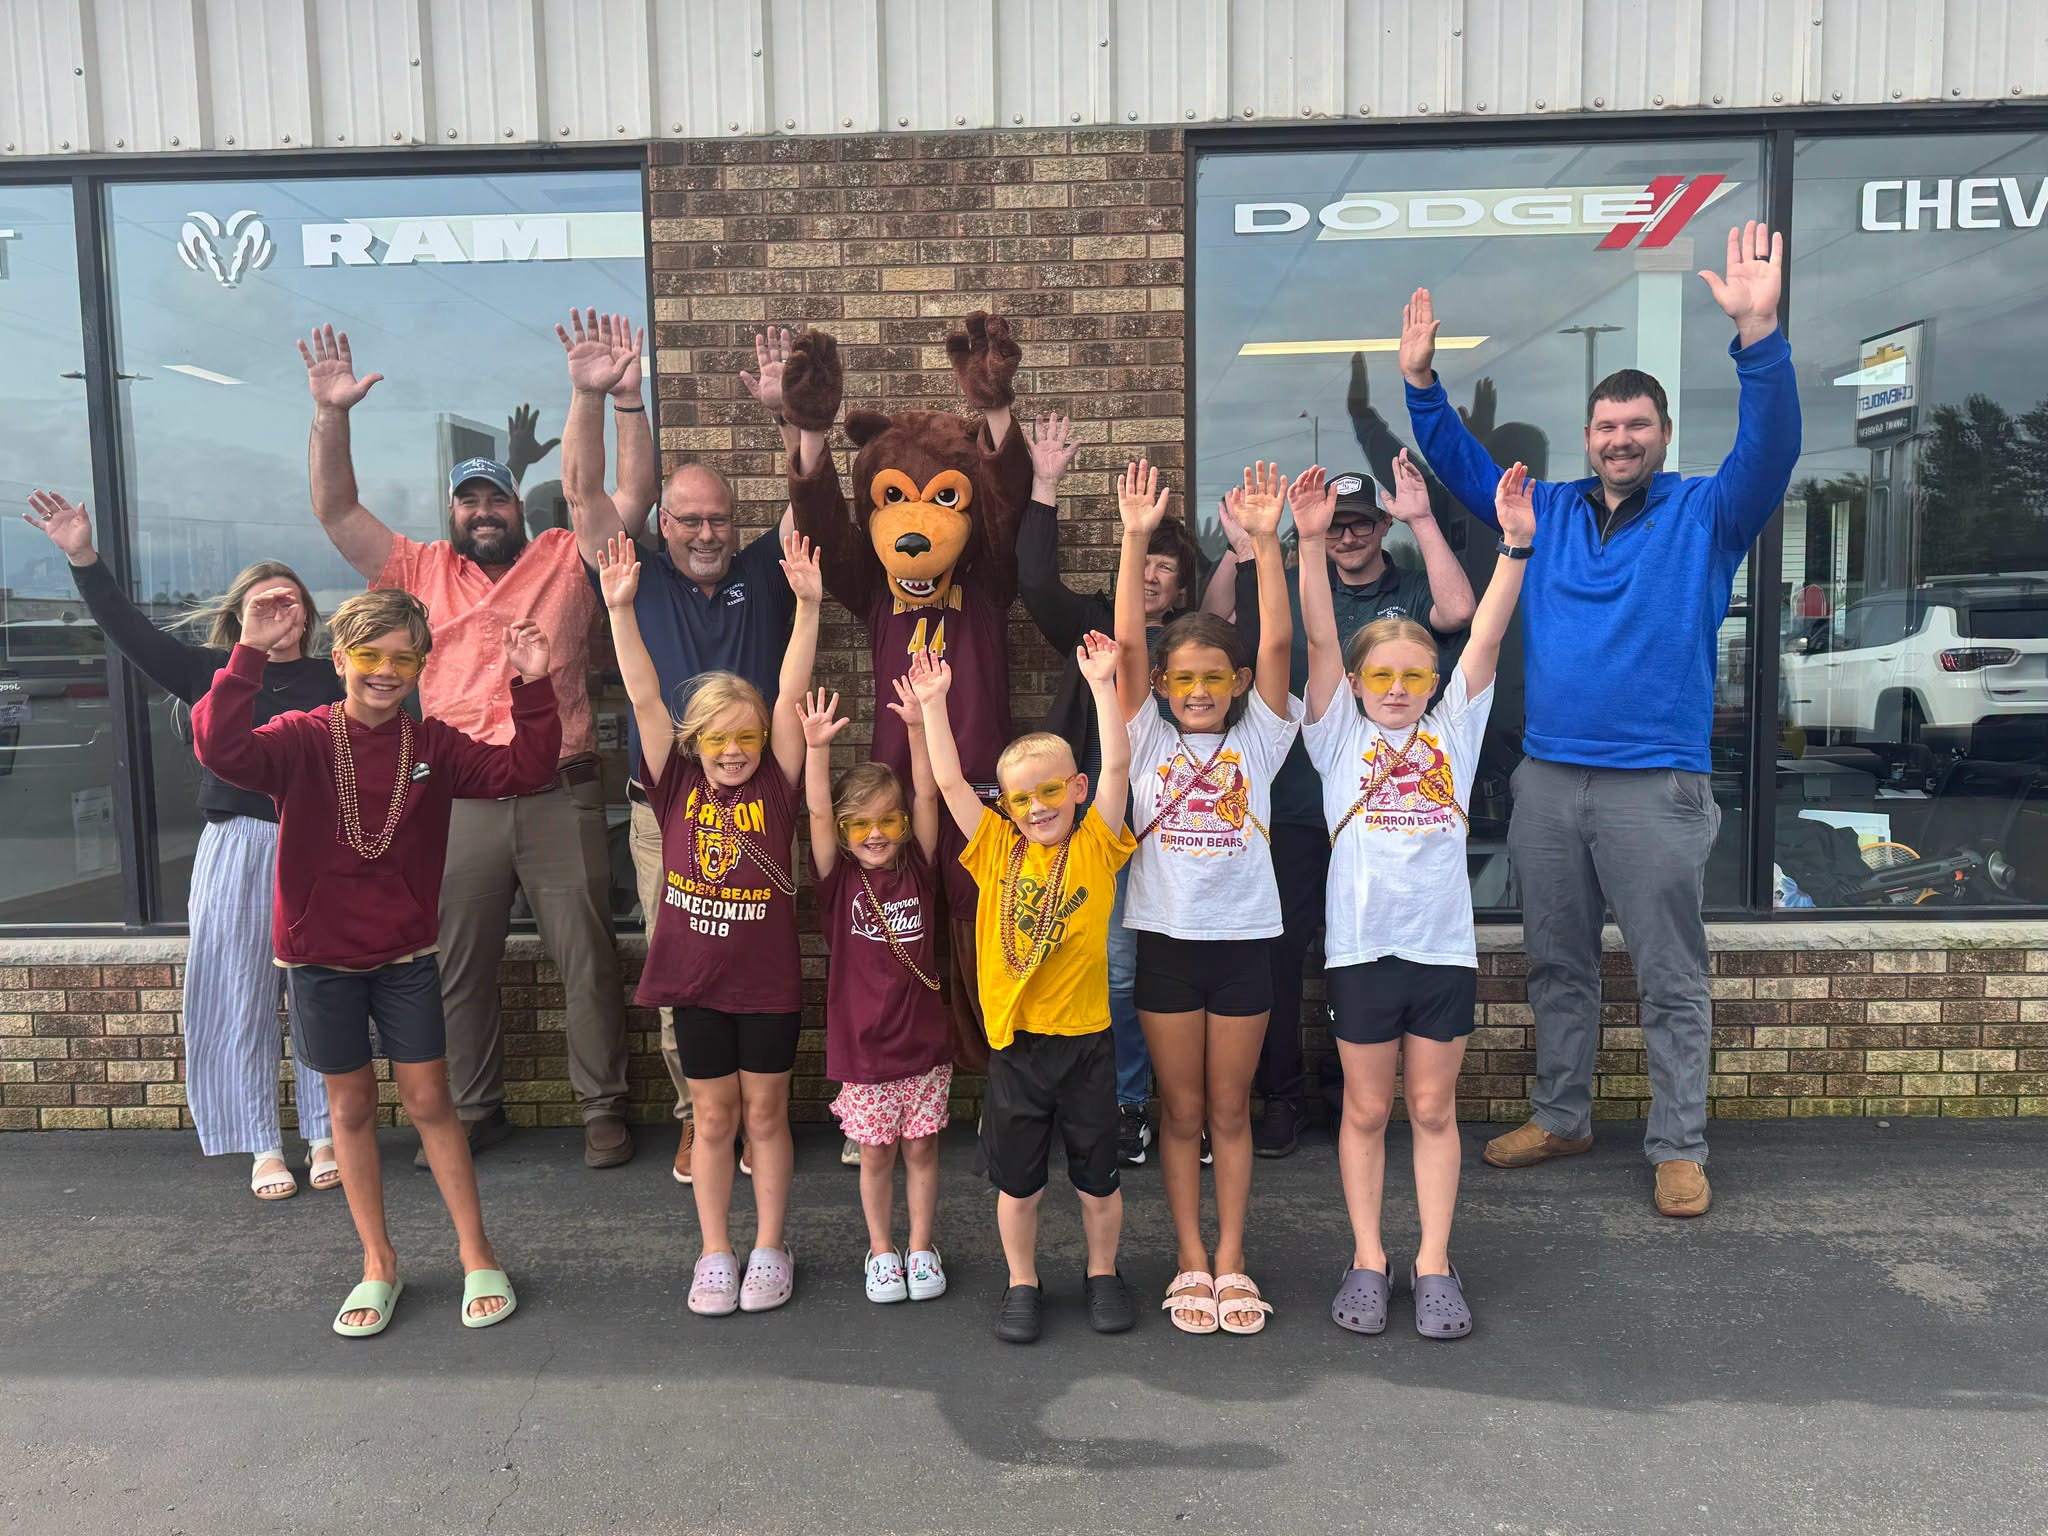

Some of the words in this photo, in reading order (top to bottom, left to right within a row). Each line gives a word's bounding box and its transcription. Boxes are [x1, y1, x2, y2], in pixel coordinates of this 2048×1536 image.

[1234, 192, 1655, 234] DODGE
[1861, 177, 2048, 231] CHEV
[302, 218, 569, 265] RAM
[1364, 815, 1415, 826] BARRON
[1206, 837, 1243, 848] BEARS
[664, 885, 767, 921] HOMECOMING
[721, 887, 772, 901] BEARS
[882, 896, 919, 916] Barron
[689, 916, 730, 938] 2018
